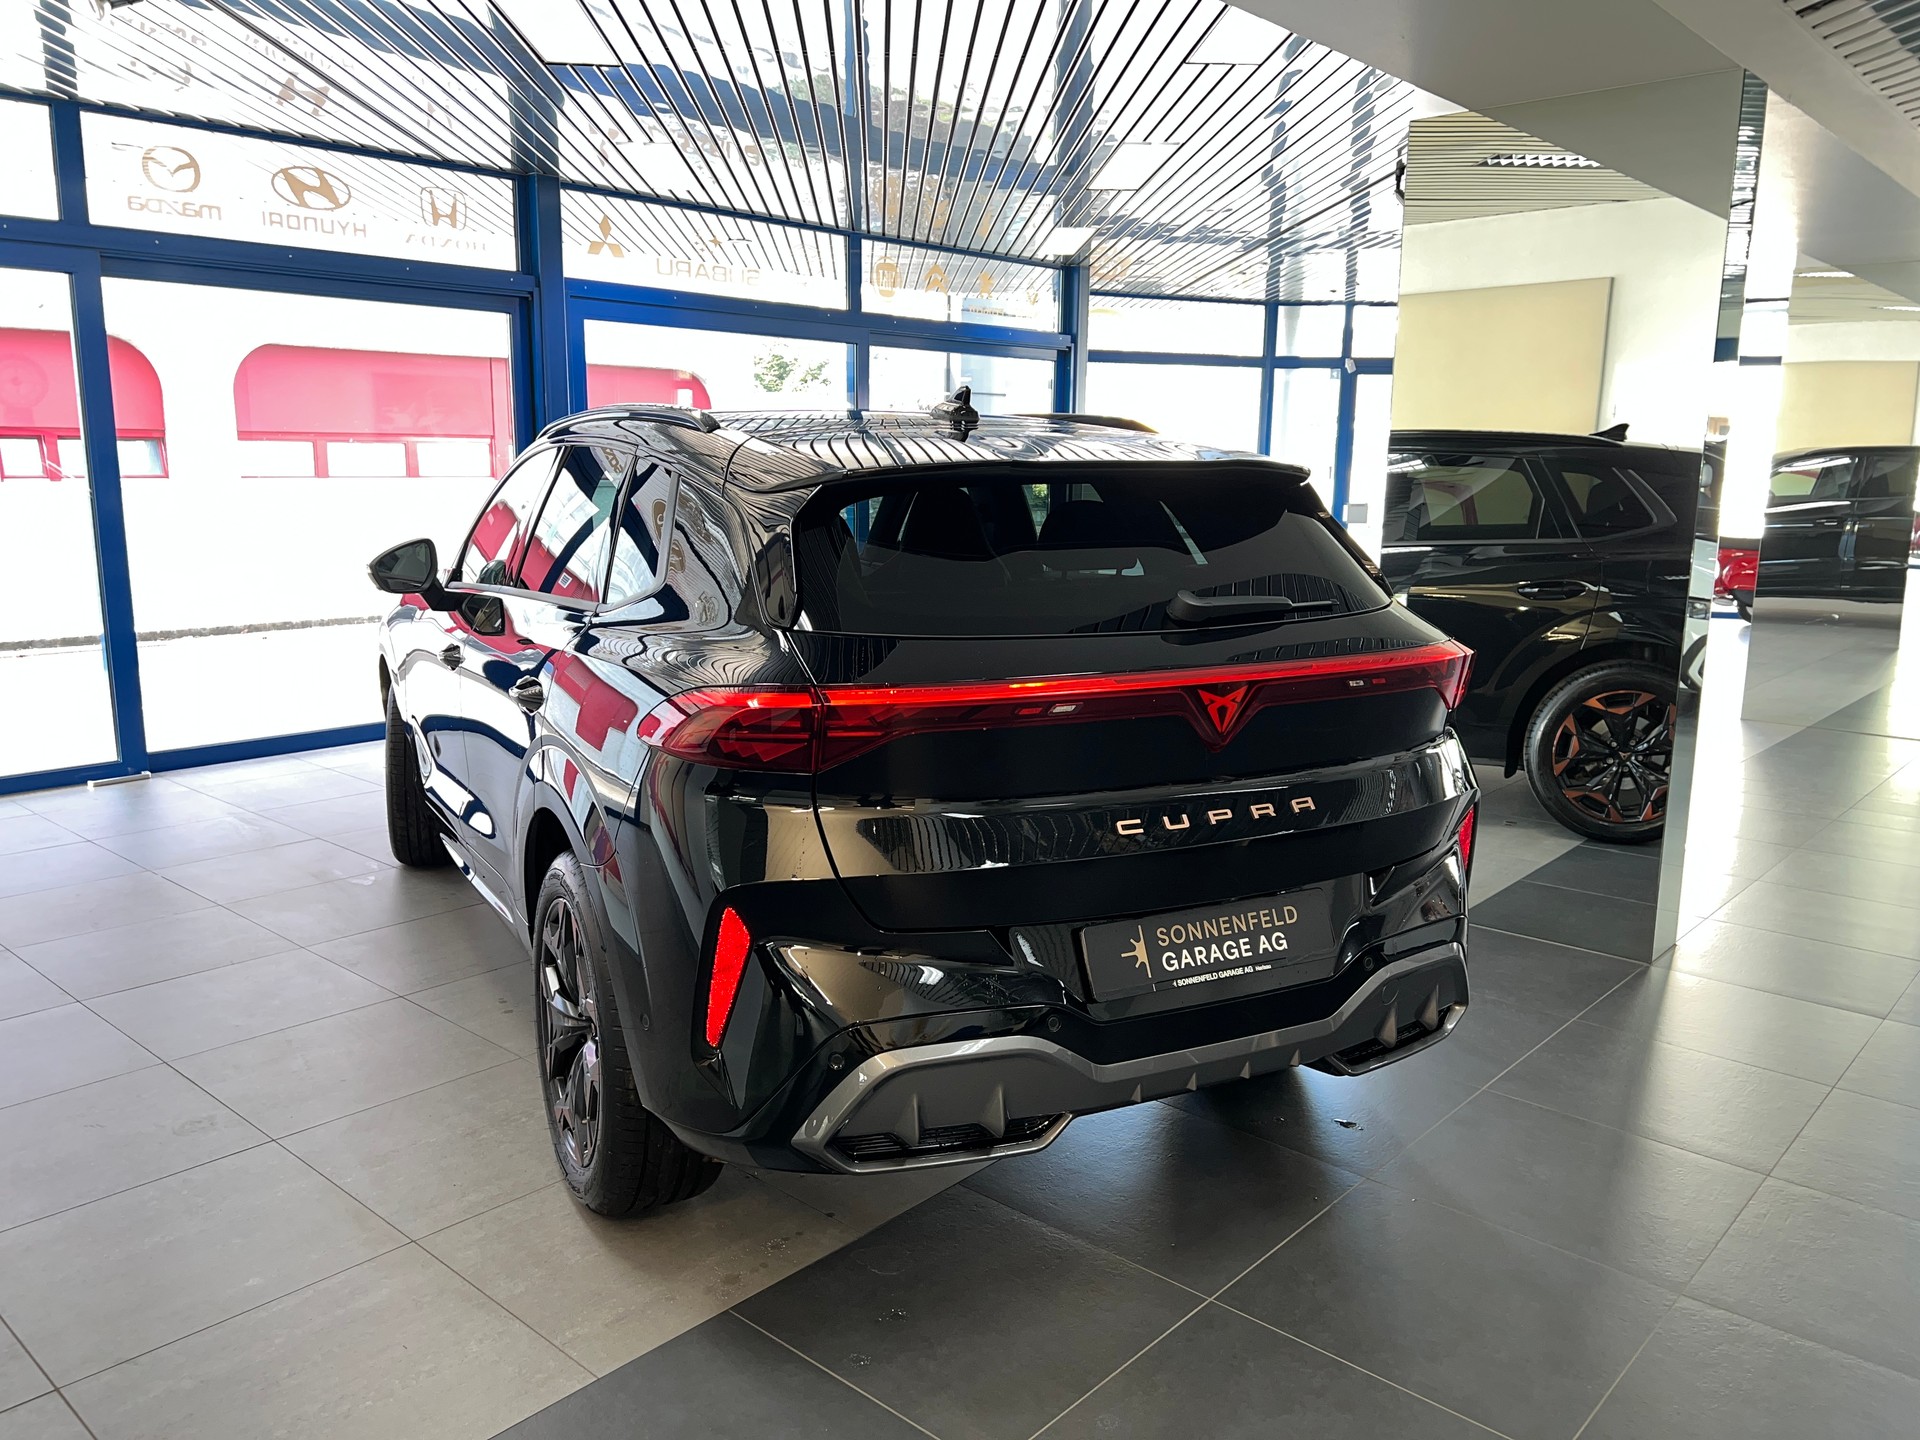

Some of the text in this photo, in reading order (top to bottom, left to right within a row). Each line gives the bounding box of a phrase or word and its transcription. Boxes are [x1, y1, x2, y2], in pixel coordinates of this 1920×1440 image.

[1115, 796, 1316, 836] CUPRA
[1156, 905, 1298, 947] SONNENFELD
[1161, 931, 1288, 972] GARAGE AG
[1177, 972, 1218, 987] SONNENFELD
[1218, 967, 1245, 979] GARAGE
[1244, 965, 1254, 974] AG
